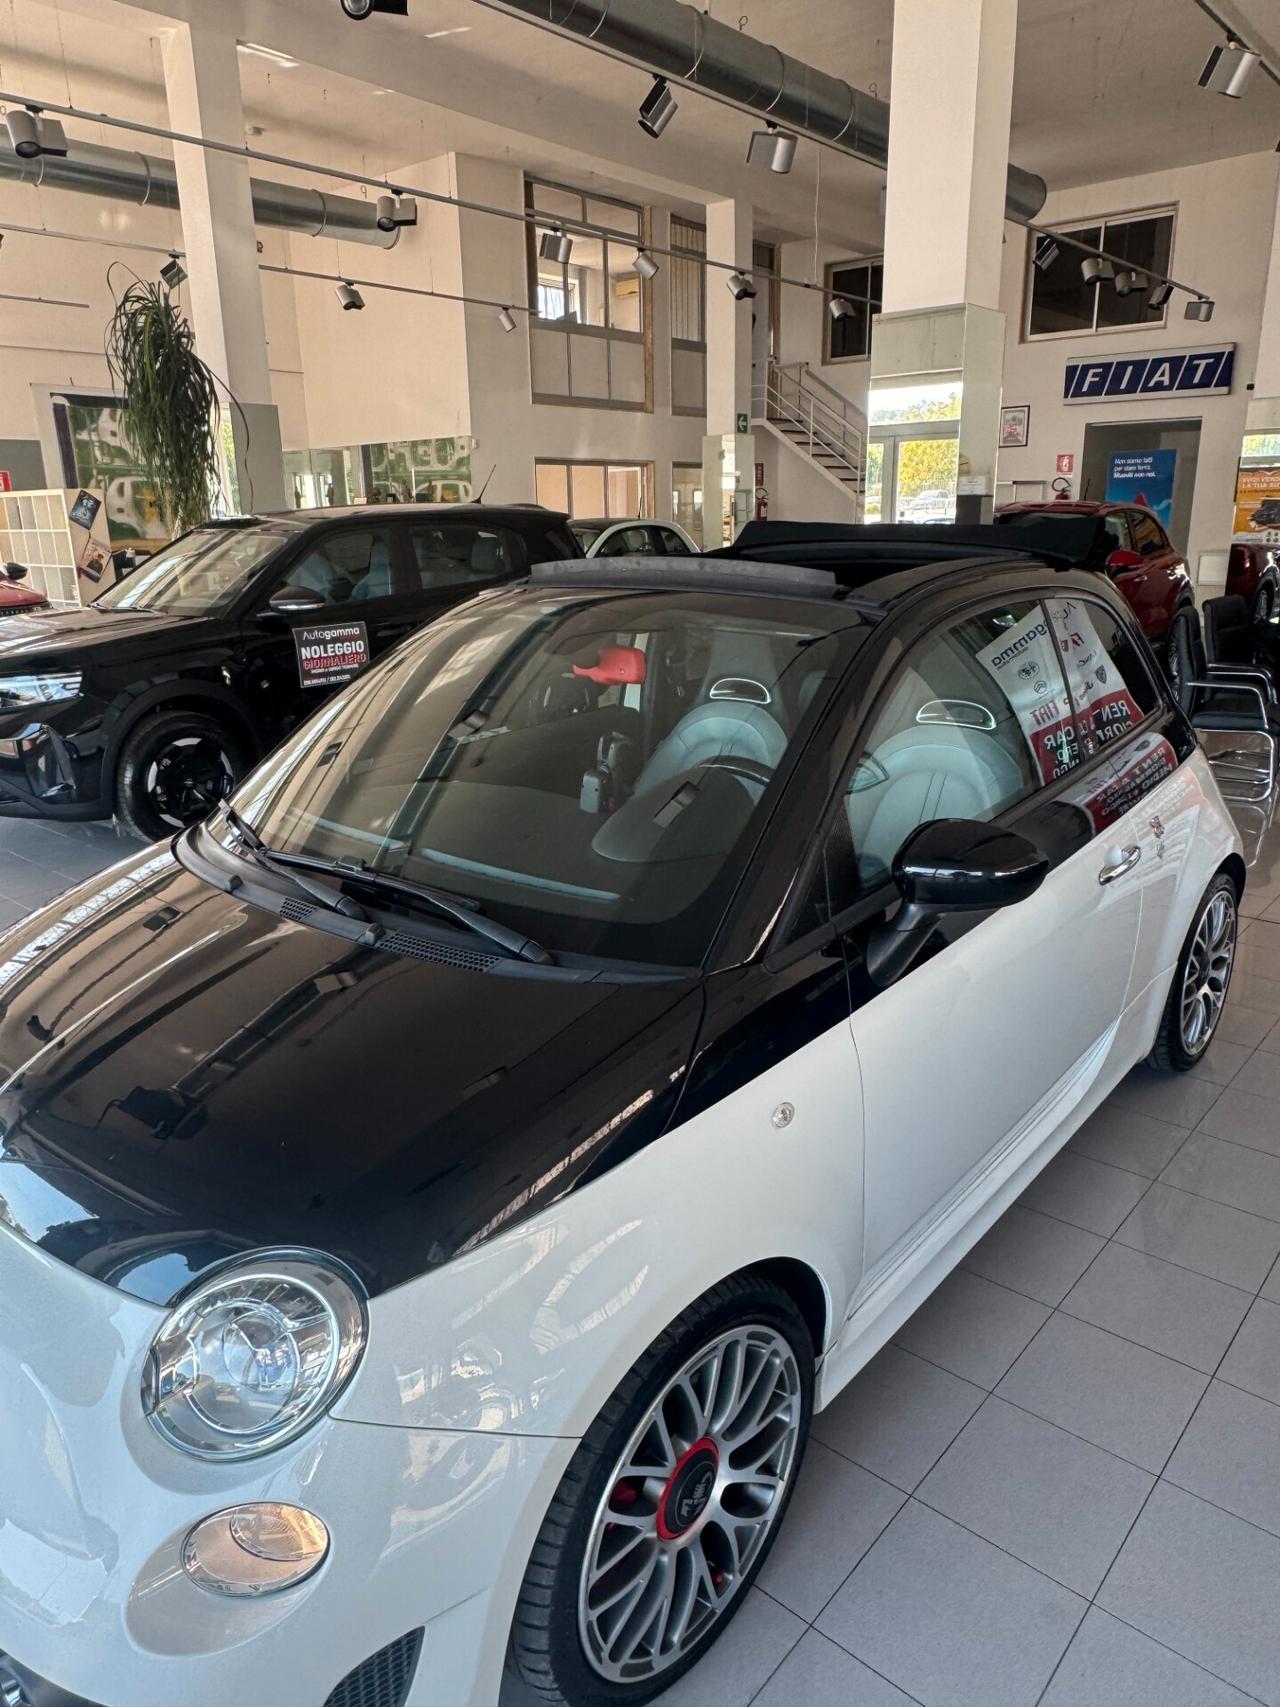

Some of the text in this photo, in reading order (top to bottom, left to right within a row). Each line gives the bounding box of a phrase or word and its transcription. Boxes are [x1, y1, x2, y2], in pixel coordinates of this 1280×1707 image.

[1082, 358, 1214, 392] FIAT
[303, 627, 360, 641] Autogamma
[300, 640, 365, 660] NOLEGGIO
[302, 653, 367, 670] GIORNALIERO
